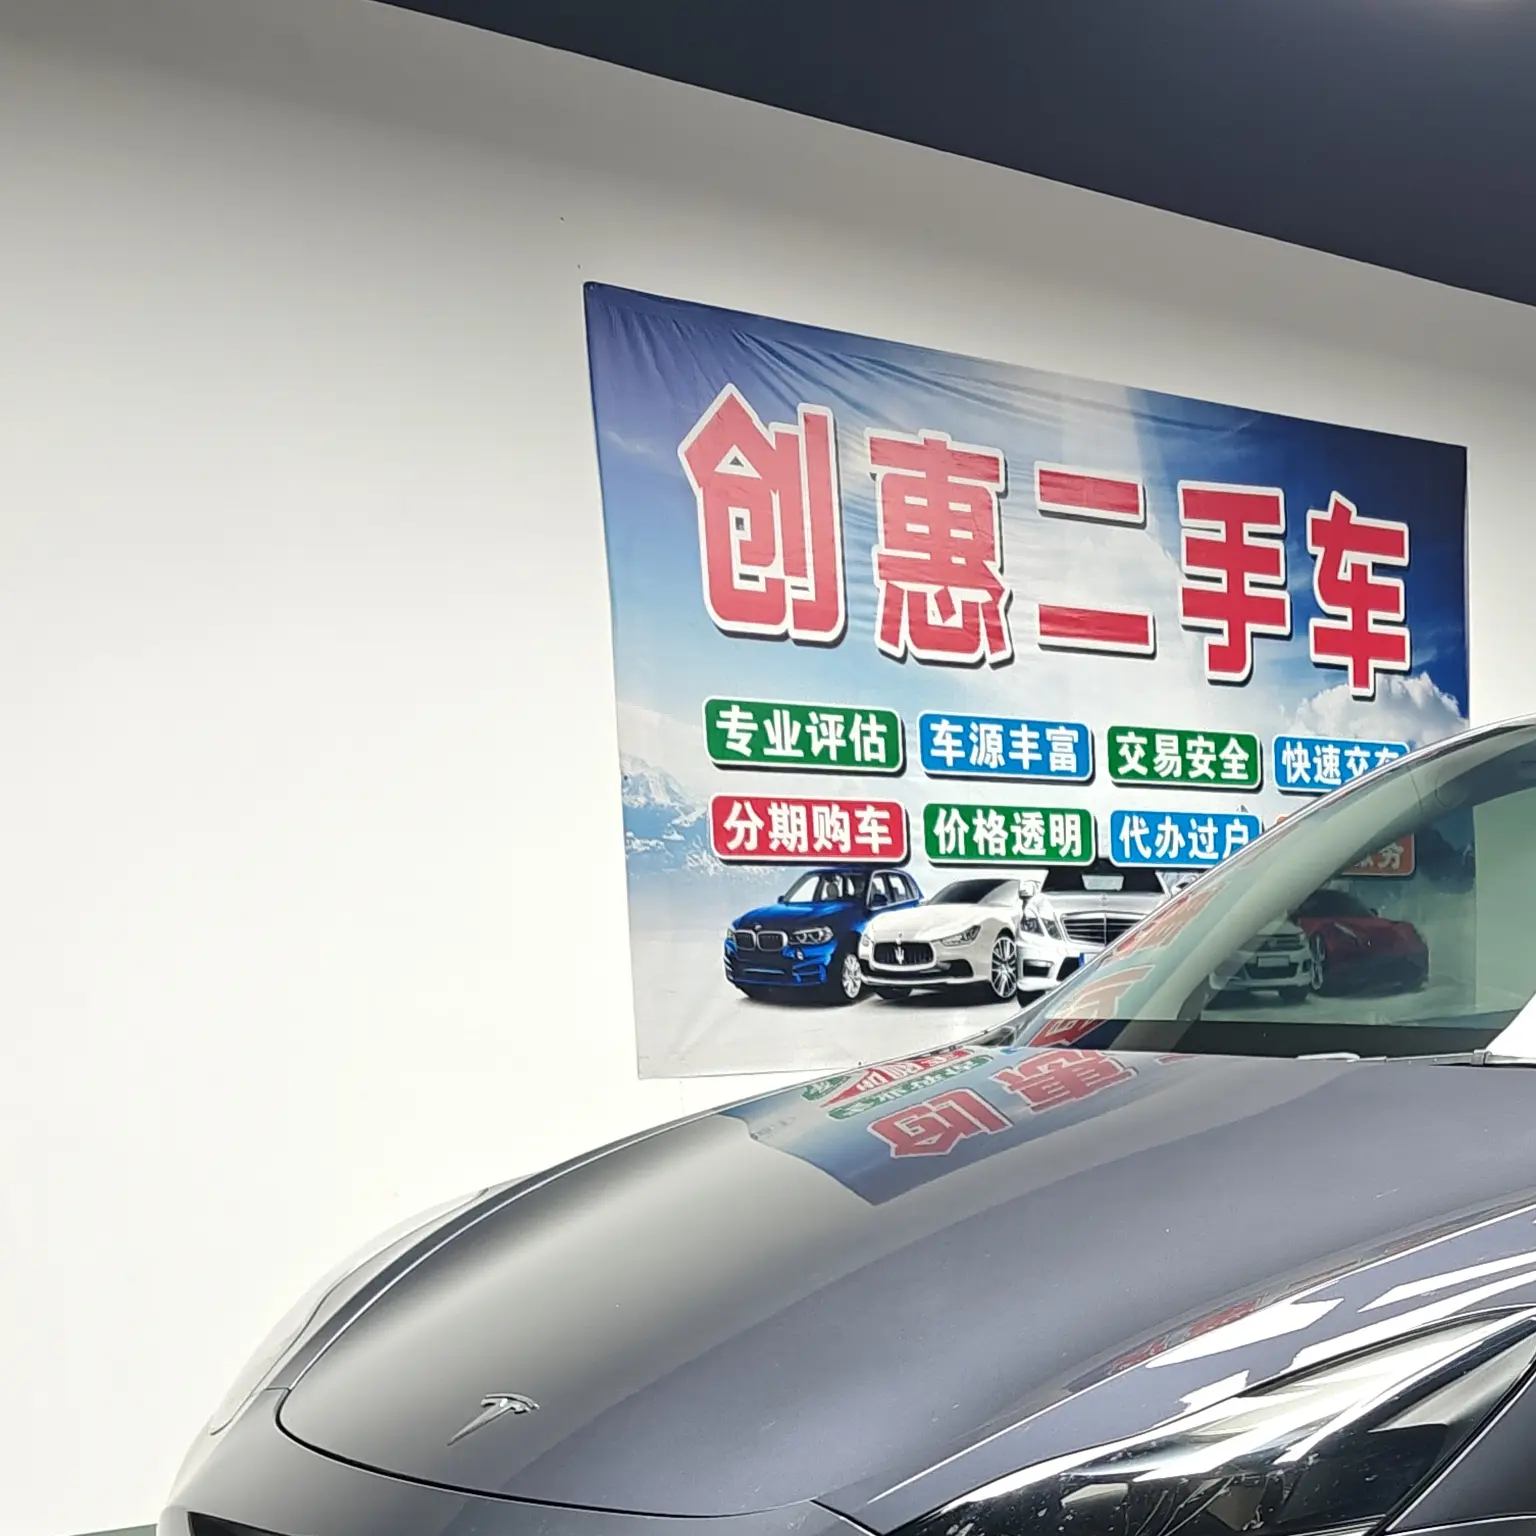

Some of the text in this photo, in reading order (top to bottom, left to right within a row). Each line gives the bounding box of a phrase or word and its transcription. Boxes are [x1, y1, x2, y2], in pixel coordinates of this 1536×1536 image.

[677, 382, 1411, 698] 创惠二手车
[715, 706, 888, 764] 专业评估
[929, 717, 1081, 775] 车源丰富
[1116, 731, 1250, 780] 交易安全
[723, 802, 893, 855] 分期购车
[933, 810, 1083, 859] 价格透明
[1119, 814, 1250, 861] 代办过户
